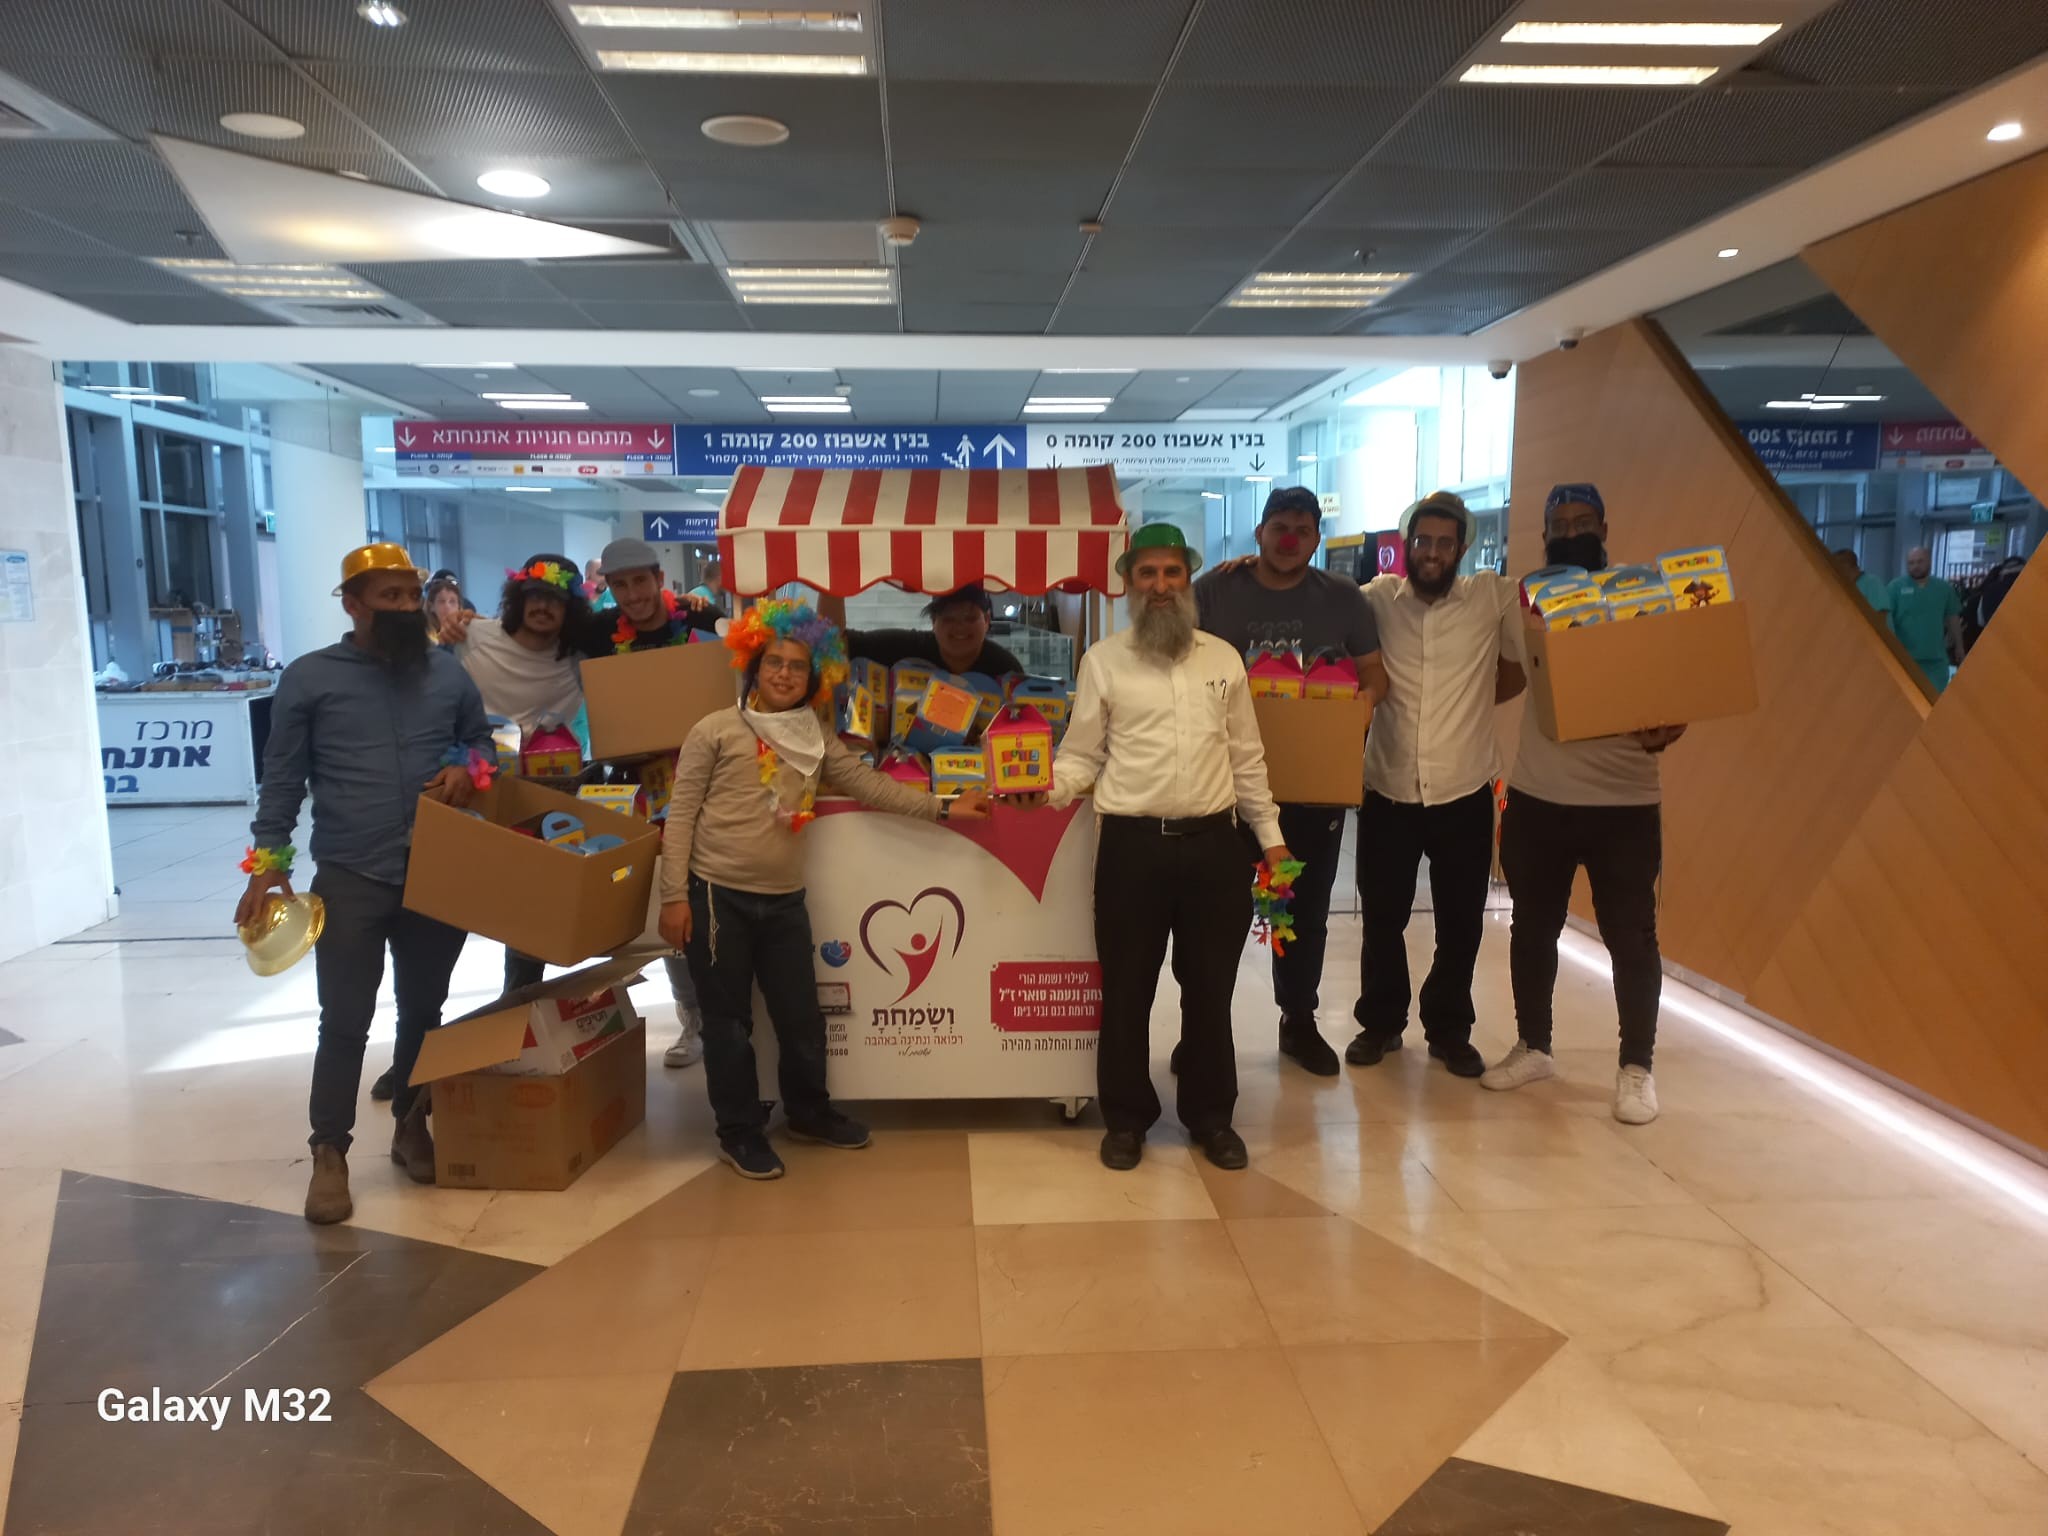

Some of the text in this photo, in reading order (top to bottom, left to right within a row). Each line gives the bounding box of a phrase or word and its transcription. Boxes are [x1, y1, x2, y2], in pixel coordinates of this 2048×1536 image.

[432, 429, 632, 446] מתחם חנויות אתנחתא
[703, 432, 930, 451] בנין אשפוז 200 קומה 1
[1046, 433, 1265, 450] בנין אשפוז 200 קומה 0
[704, 452, 928, 465] חדרי ניתוח, טיפול נמרץ ילדים, מרכז מסחרי
[685, 518, 708, 527] דימות
[136, 719, 213, 741] מרכז
[1018, 971, 1089, 985] לעילוי נשמת הורי
[1018, 989, 1047, 1002] סוארי
[1049, 989, 1080, 1002] ונעמה
[1013, 1005, 1031, 1017] ביתו
[1033, 1005, 1048, 1017] ובני
[1068, 1005, 1095, 1016] תרומת
[865, 1035, 963, 1046] רפואה ונתינה באהבה
[1001, 1036, 1098, 1051] יאות והחלמה מהירה
